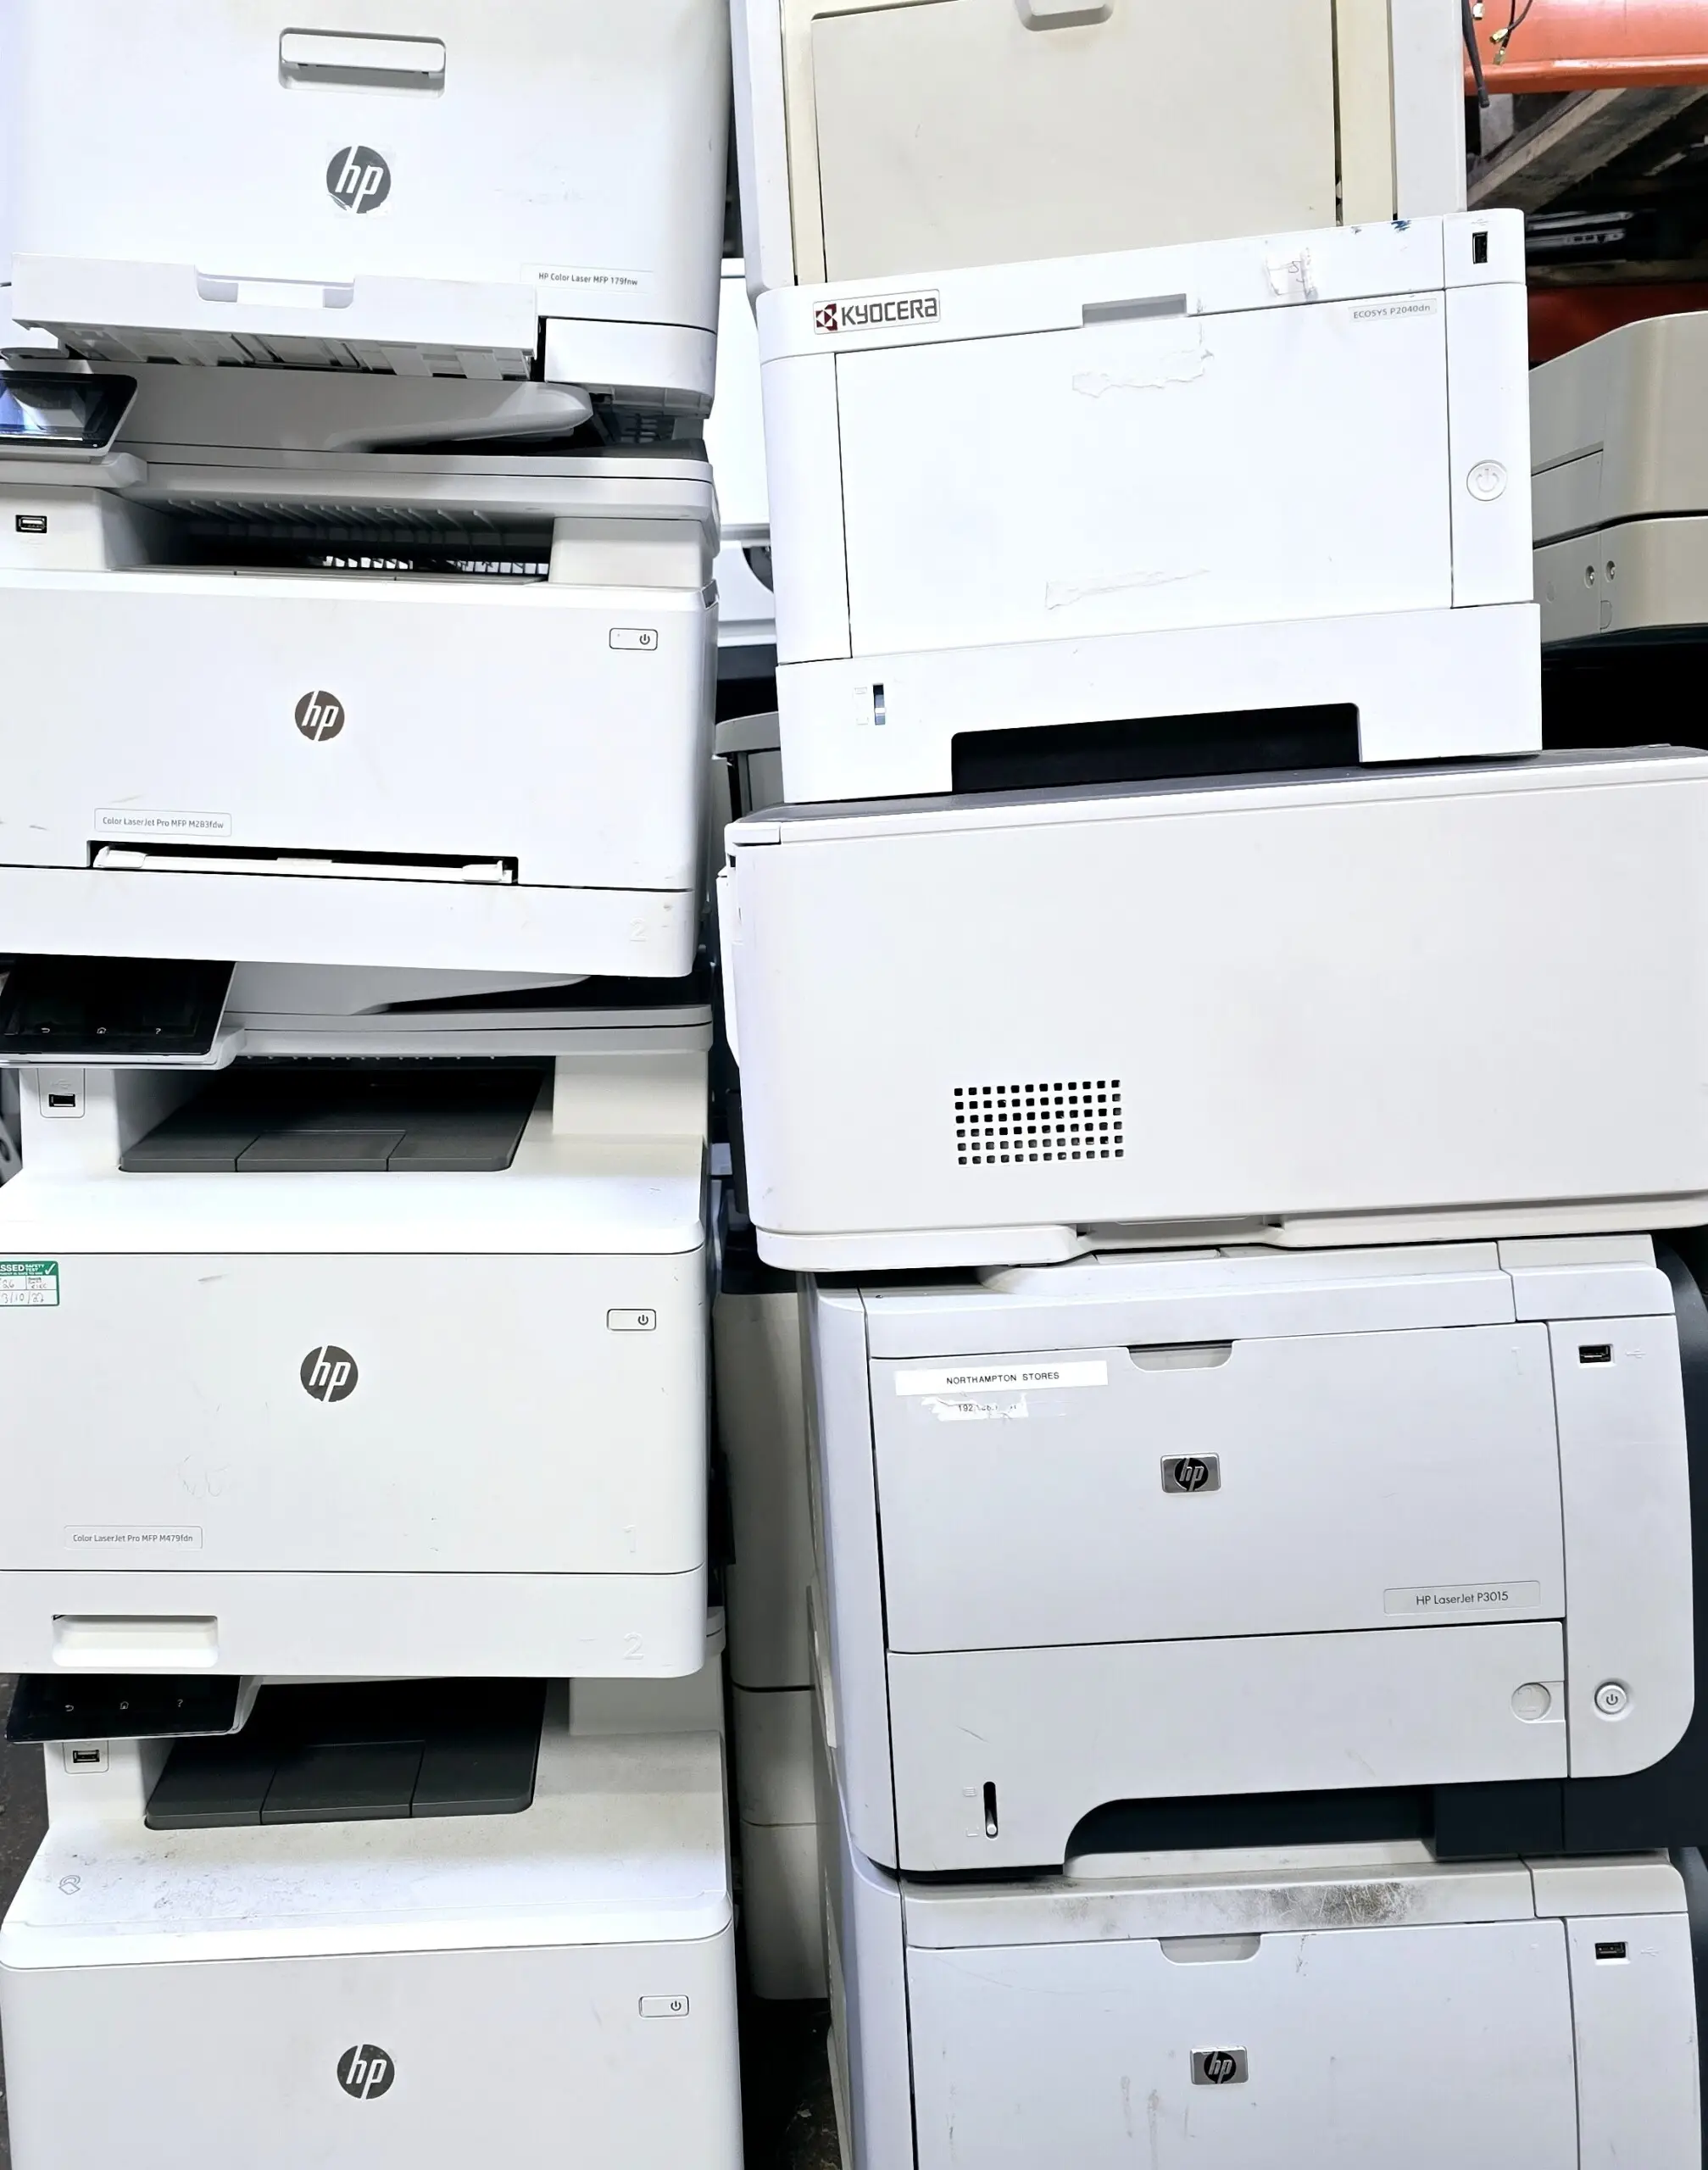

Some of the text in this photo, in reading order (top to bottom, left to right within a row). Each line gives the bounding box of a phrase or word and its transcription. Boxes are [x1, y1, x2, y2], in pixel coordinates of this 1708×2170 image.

[334, 146, 384, 214] hp
[538, 272, 638, 286] HP Color Laser MFP 179fnw
[1353, 304, 1431, 319] ECOSYS P2040dn
[302, 690, 340, 742] hp
[103, 816, 122, 826] Color
[124, 817, 155, 826] LaserJet
[157, 819, 170, 827] Pro
[188, 820, 224, 829] M283fdw
[308, 1345, 352, 1402] hp
[946, 1372, 1060, 1385] NORTHAMPTON STORES
[1179, 1457, 1205, 1491] hp
[1416, 1591, 1509, 1605] HP LaserJet P3015
[345, 2044, 387, 2100] hp
[1209, 2050, 1233, 2084] hp
